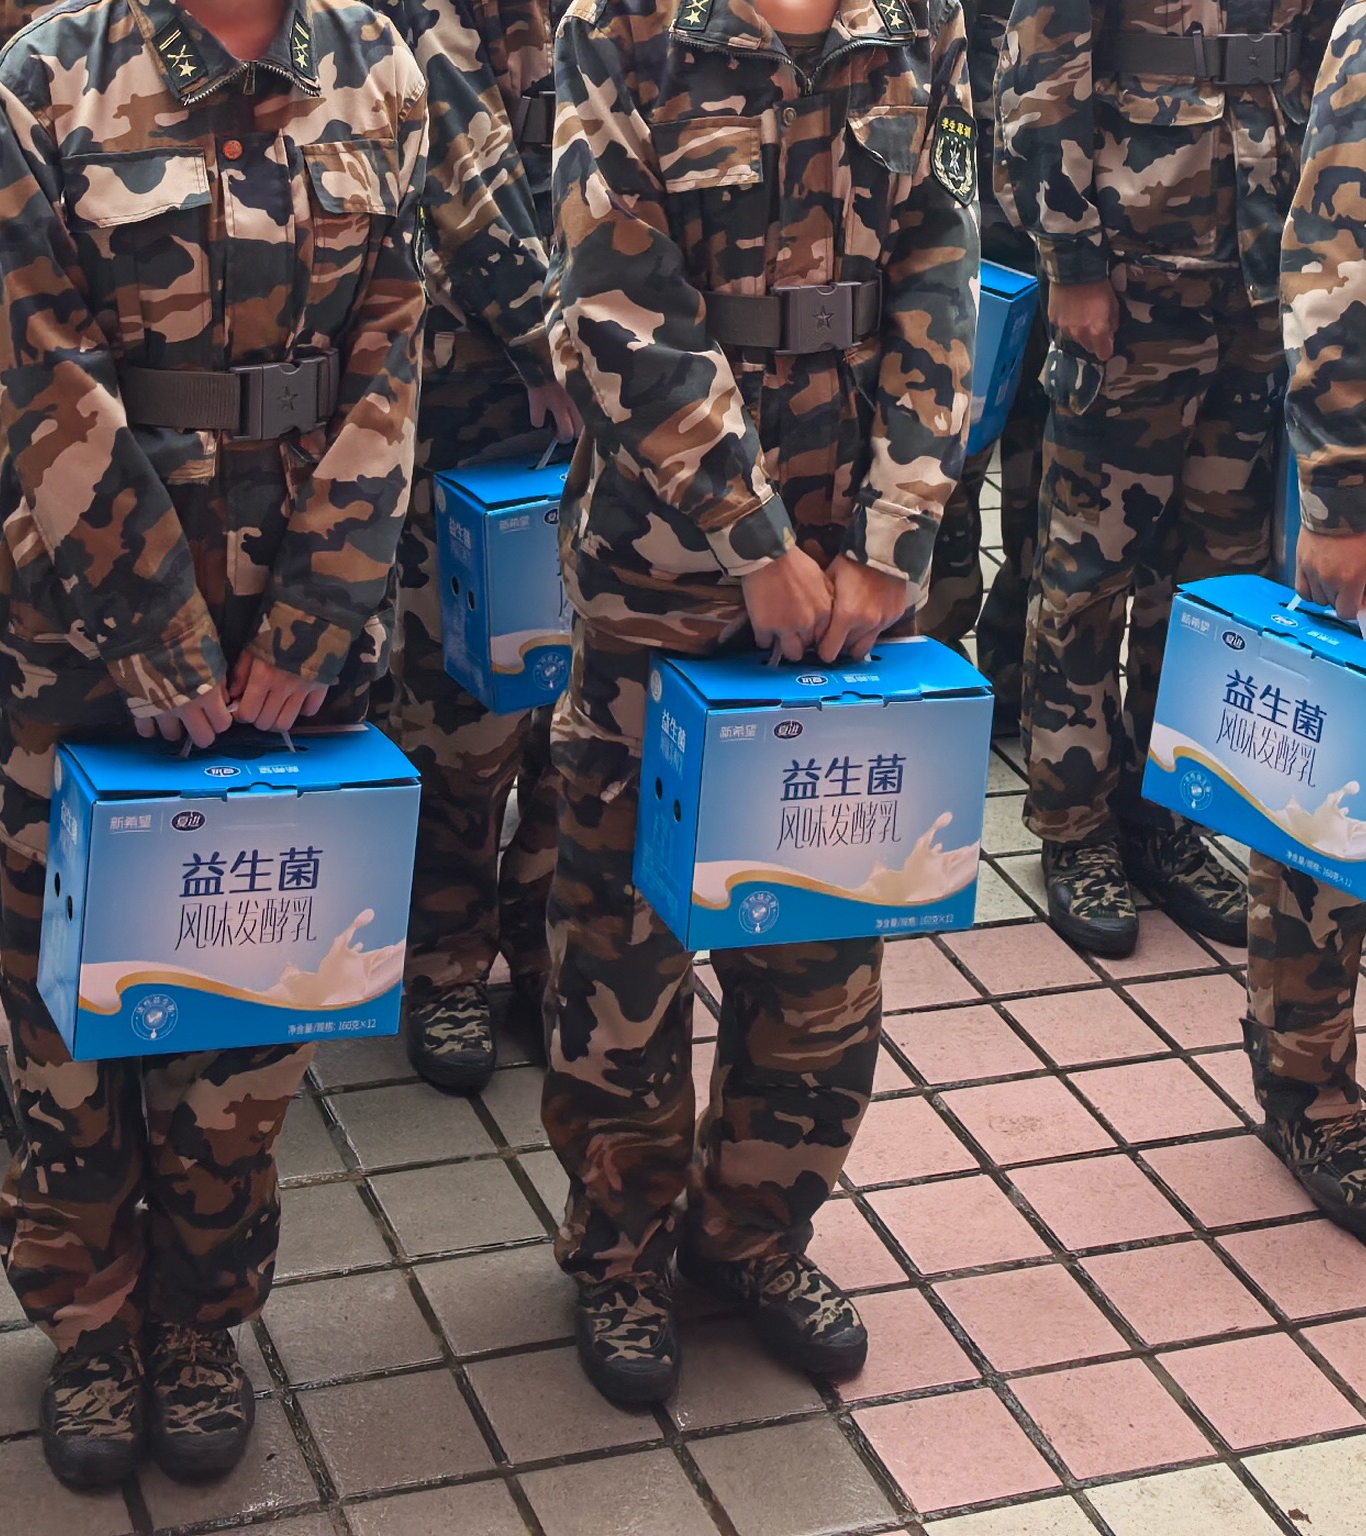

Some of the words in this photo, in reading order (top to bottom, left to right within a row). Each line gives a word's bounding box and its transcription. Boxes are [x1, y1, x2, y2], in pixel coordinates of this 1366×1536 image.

[660, 709, 686, 754] 益生菌
[1221, 670, 1328, 744] 益生菌
[1215, 707, 1317, 788] 风味发酵乳
[779, 753, 906, 802] 益生菌
[776, 799, 902, 852] 风味发酵乳
[178, 846, 324, 898] 益生菌
[174, 895, 318, 952] 风味发酵乳
